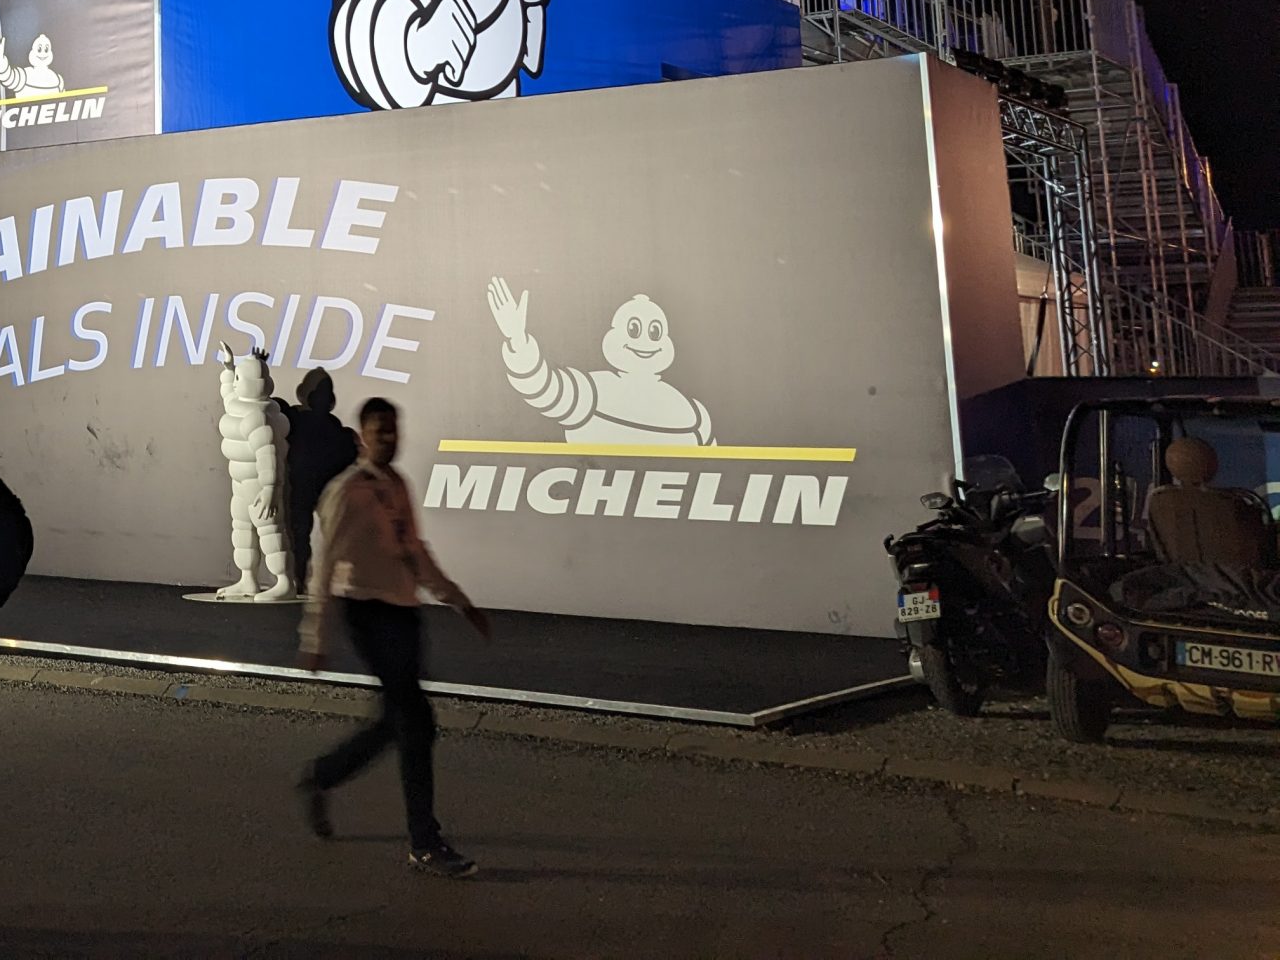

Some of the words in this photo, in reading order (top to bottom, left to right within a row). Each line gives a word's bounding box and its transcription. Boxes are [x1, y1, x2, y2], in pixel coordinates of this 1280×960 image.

[132, 291, 437, 385] INSIDE
[423, 464, 849, 526] MICHELIN
[1188, 645, 1280, 673] CM-961-R
